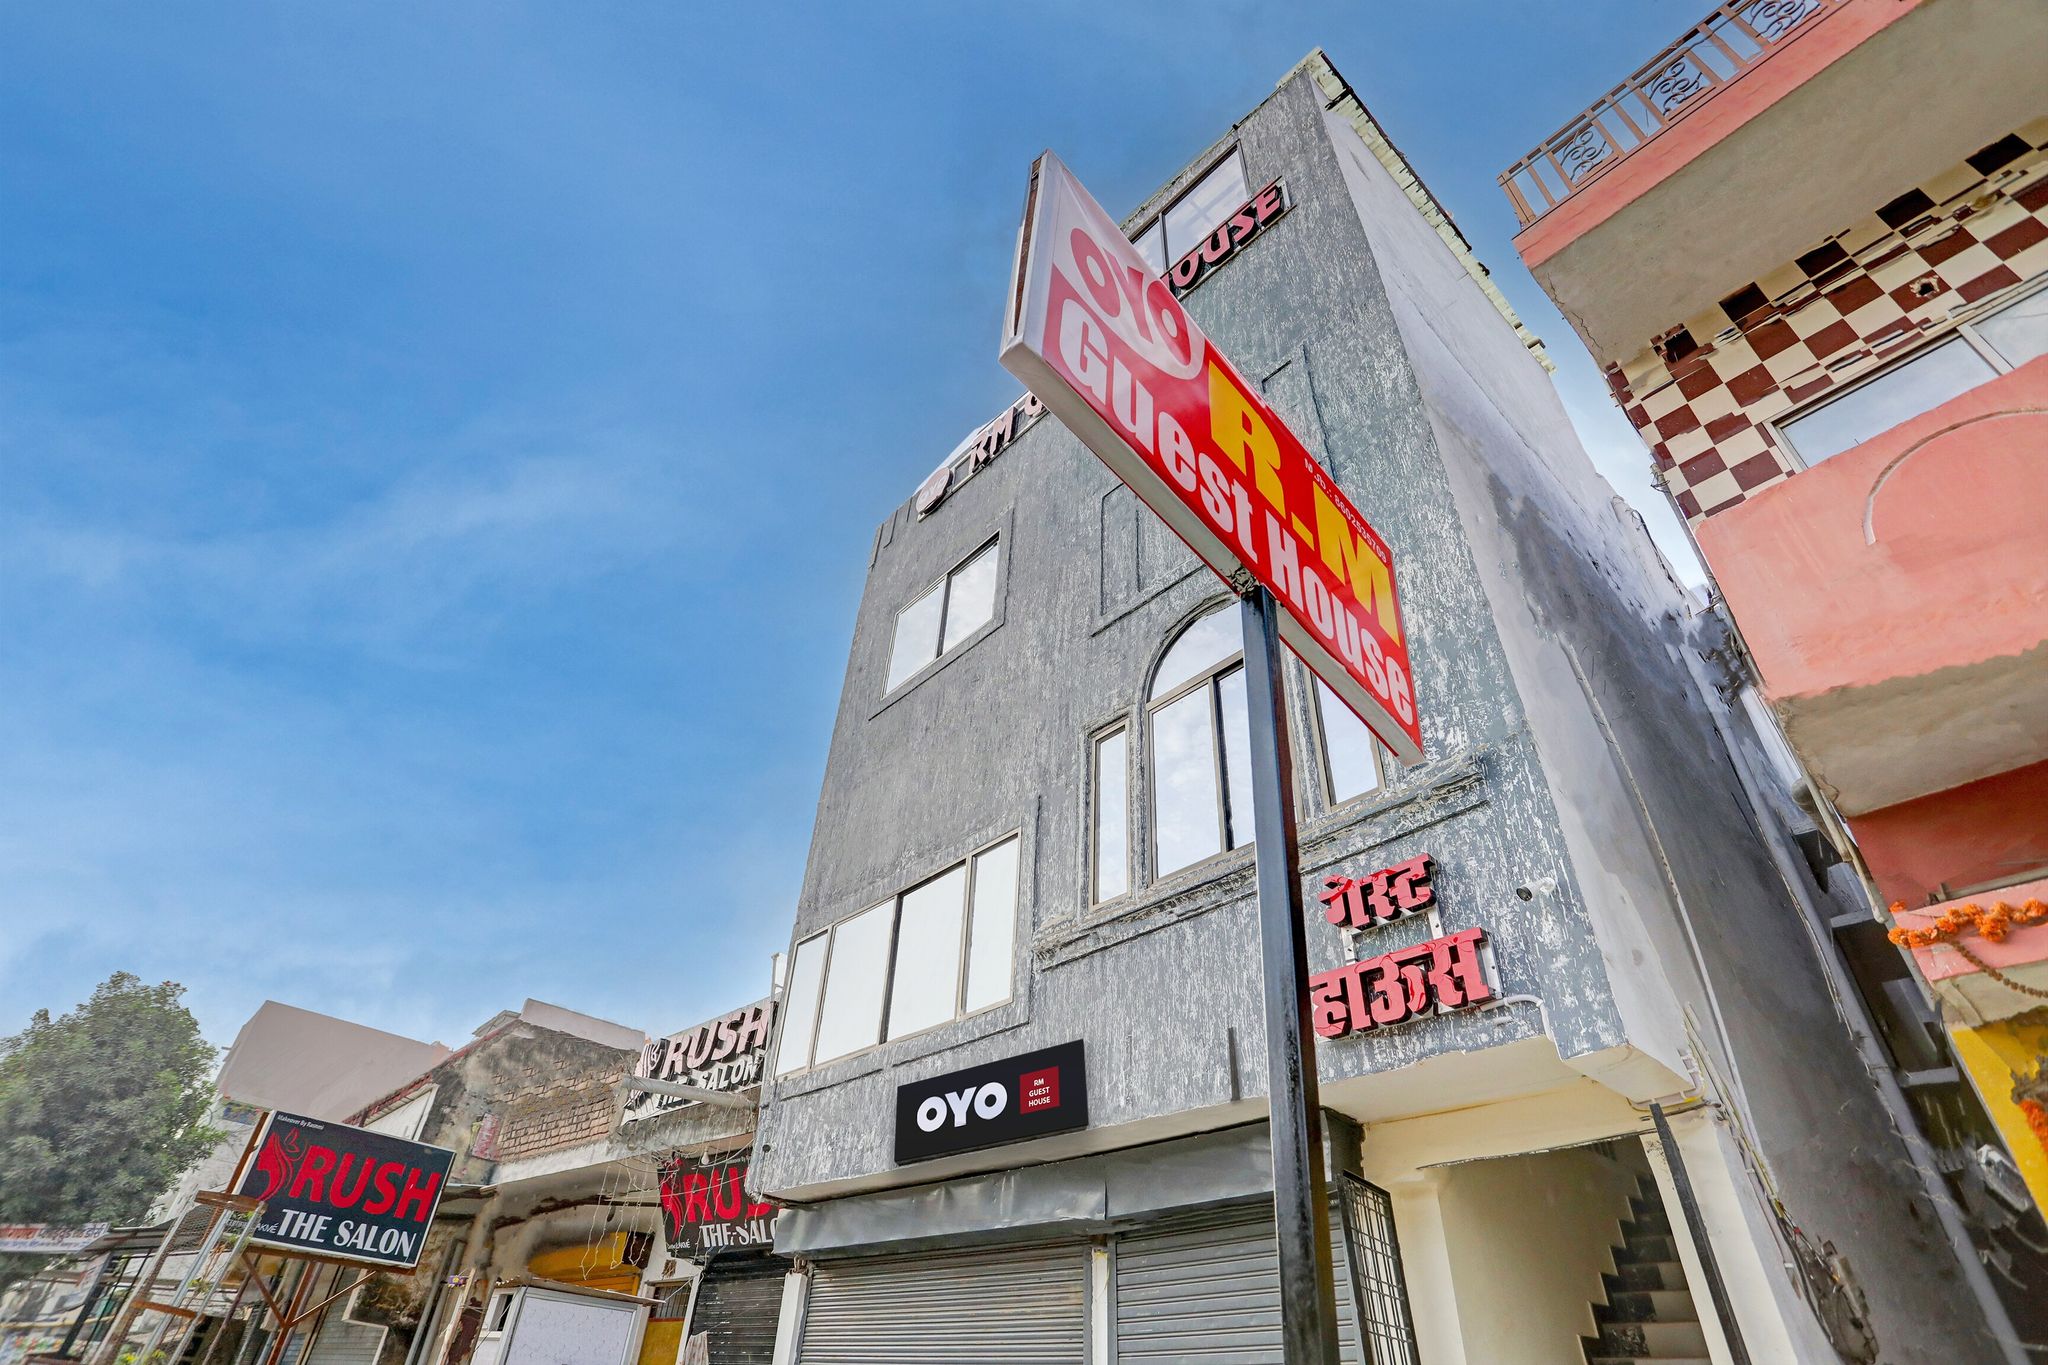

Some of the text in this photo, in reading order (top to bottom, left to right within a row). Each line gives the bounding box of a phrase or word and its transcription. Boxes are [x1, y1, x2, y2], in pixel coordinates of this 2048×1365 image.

[1070, 227, 1191, 367] OYO
[969, 407, 1017, 475] RM
[1059, 299, 1414, 726] Guest House
[1319, 853, 1434, 927] गेस्ट
[660, 1007, 769, 1075] RUSH
[696, 1057, 760, 1091] SALON
[1028, 1086, 1050, 1097] GUEST
[1028, 1096, 1051, 1106] HOUSE
[1033, 1078, 1044, 1087] RM
[917, 1082, 1008, 1133] OYO
[290, 1145, 441, 1222] RUSH
[277, 1209, 332, 1243] THE
[334, 1220, 416, 1257] SALON
